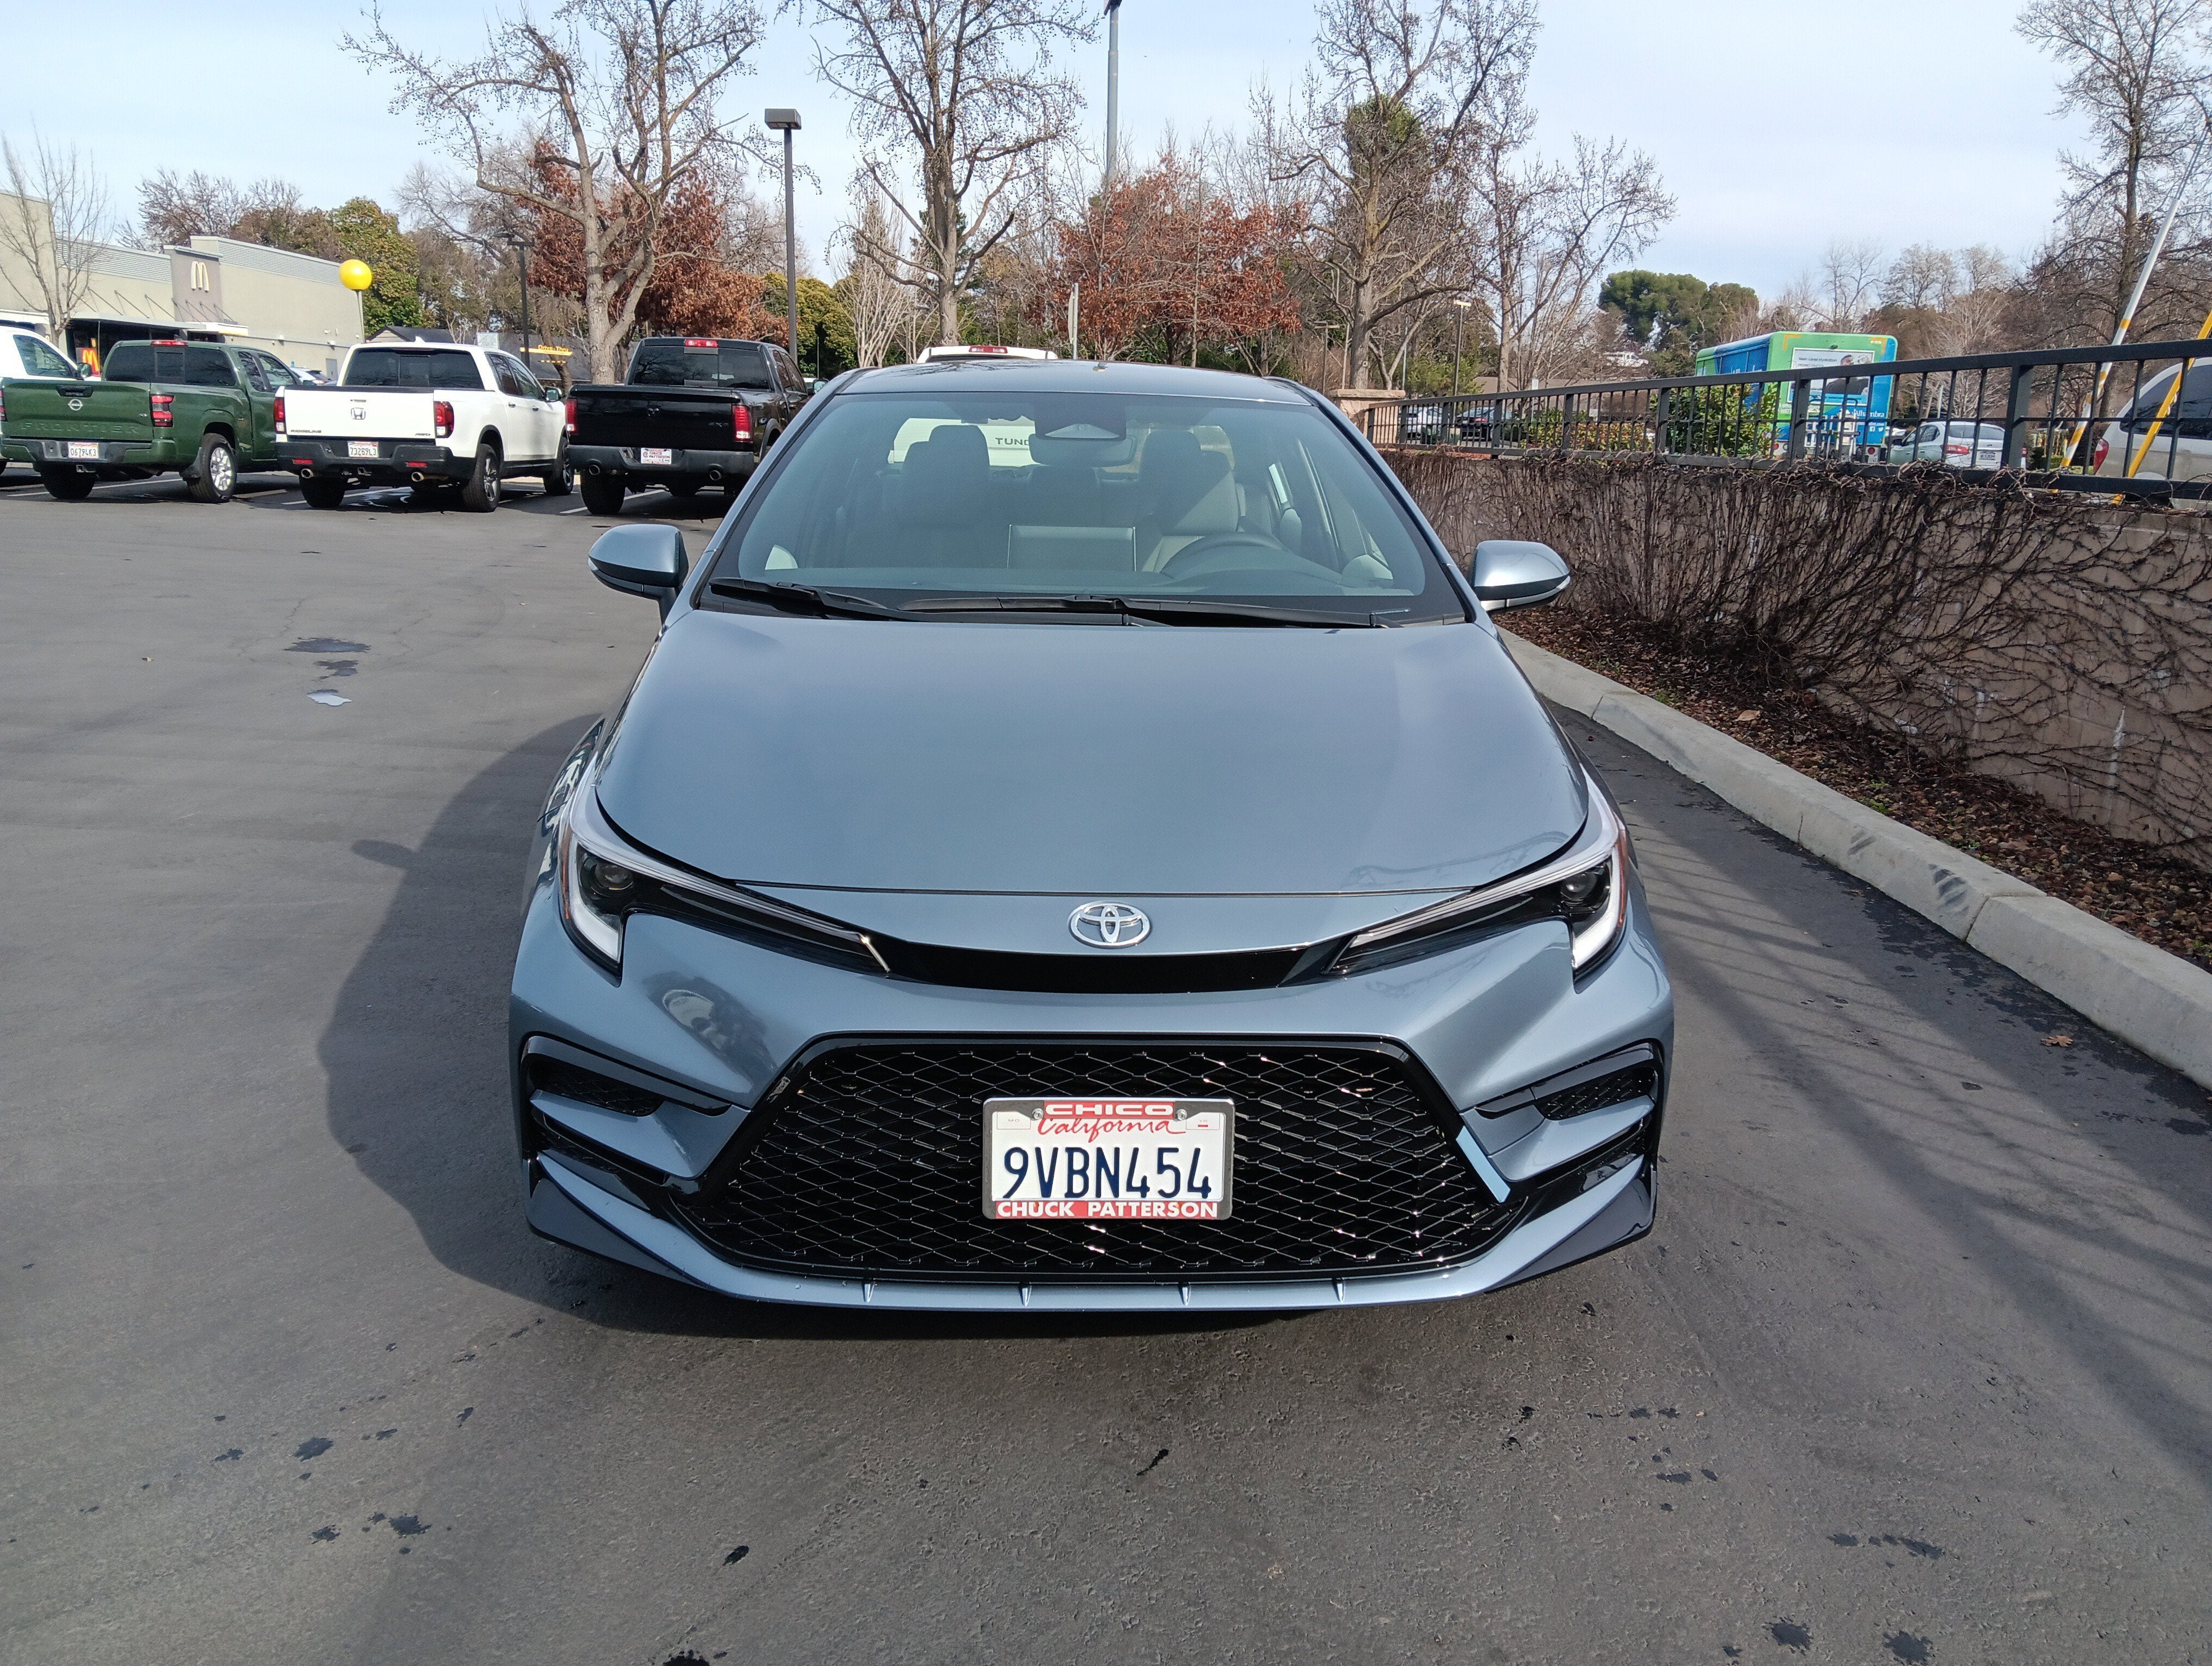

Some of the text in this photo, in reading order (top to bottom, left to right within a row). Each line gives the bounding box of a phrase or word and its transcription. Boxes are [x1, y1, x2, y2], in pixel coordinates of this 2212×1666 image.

[1045, 1104, 1173, 1116] CHICO
[1037, 1117, 1186, 1143] California
[1002, 1146, 1212, 1199] 9VBN454
[997, 1201, 1218, 1218] CHUCK PATTERSON
